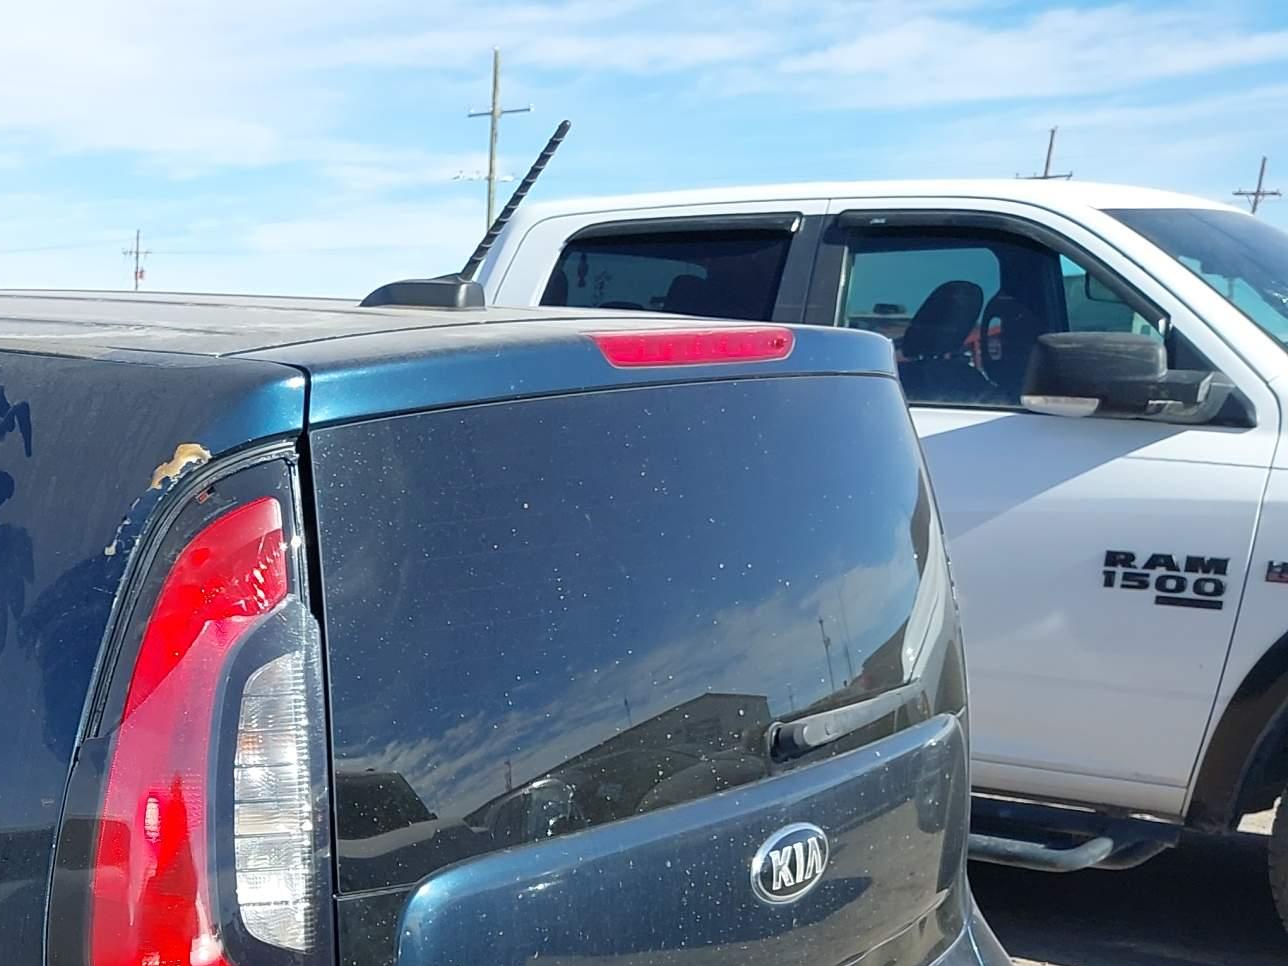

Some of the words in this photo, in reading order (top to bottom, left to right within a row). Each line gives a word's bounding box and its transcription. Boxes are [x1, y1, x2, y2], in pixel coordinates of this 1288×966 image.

[1104, 550, 1230, 576] RAM
[1103, 570, 1226, 597] 1500
[769, 837, 823, 890] KIA
